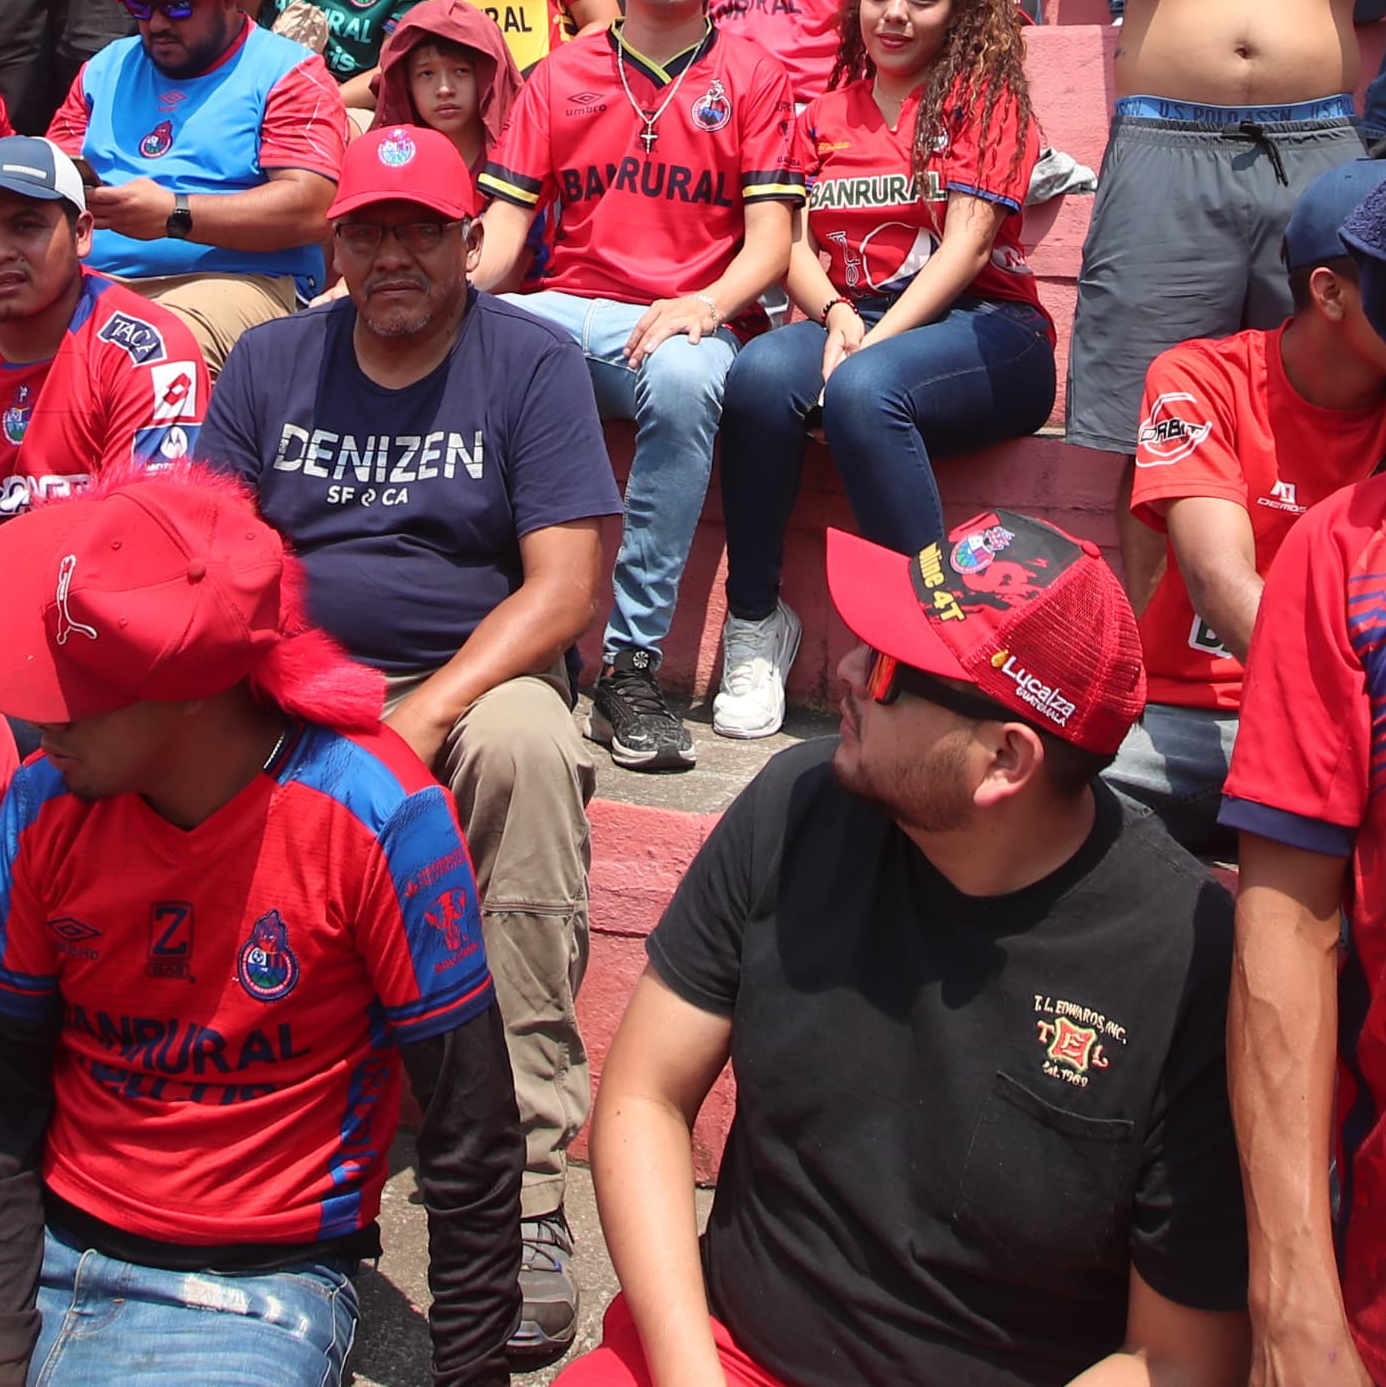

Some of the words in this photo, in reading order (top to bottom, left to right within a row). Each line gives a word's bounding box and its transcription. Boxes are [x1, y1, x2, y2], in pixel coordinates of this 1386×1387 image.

[566, 103, 607, 117] umbro
[1193, 105, 1239, 121] POLO
[810, 170, 948, 212] BANRURAL
[111, 318, 160, 356] TACA
[1140, 417, 1211, 445] ORBIT
[272, 422, 484, 483] DENIZEN
[327, 485, 355, 505] SF
[381, 487, 409, 505] CA
[933, 591, 965, 622] 4T
[1001, 656, 1076, 719] Lucalza
[1015, 687, 1066, 728] GUATEMALA
[152, 906, 188, 958] Z
[1043, 997, 1054, 1014] L.
[1105, 1020, 1127, 1045] INC.
